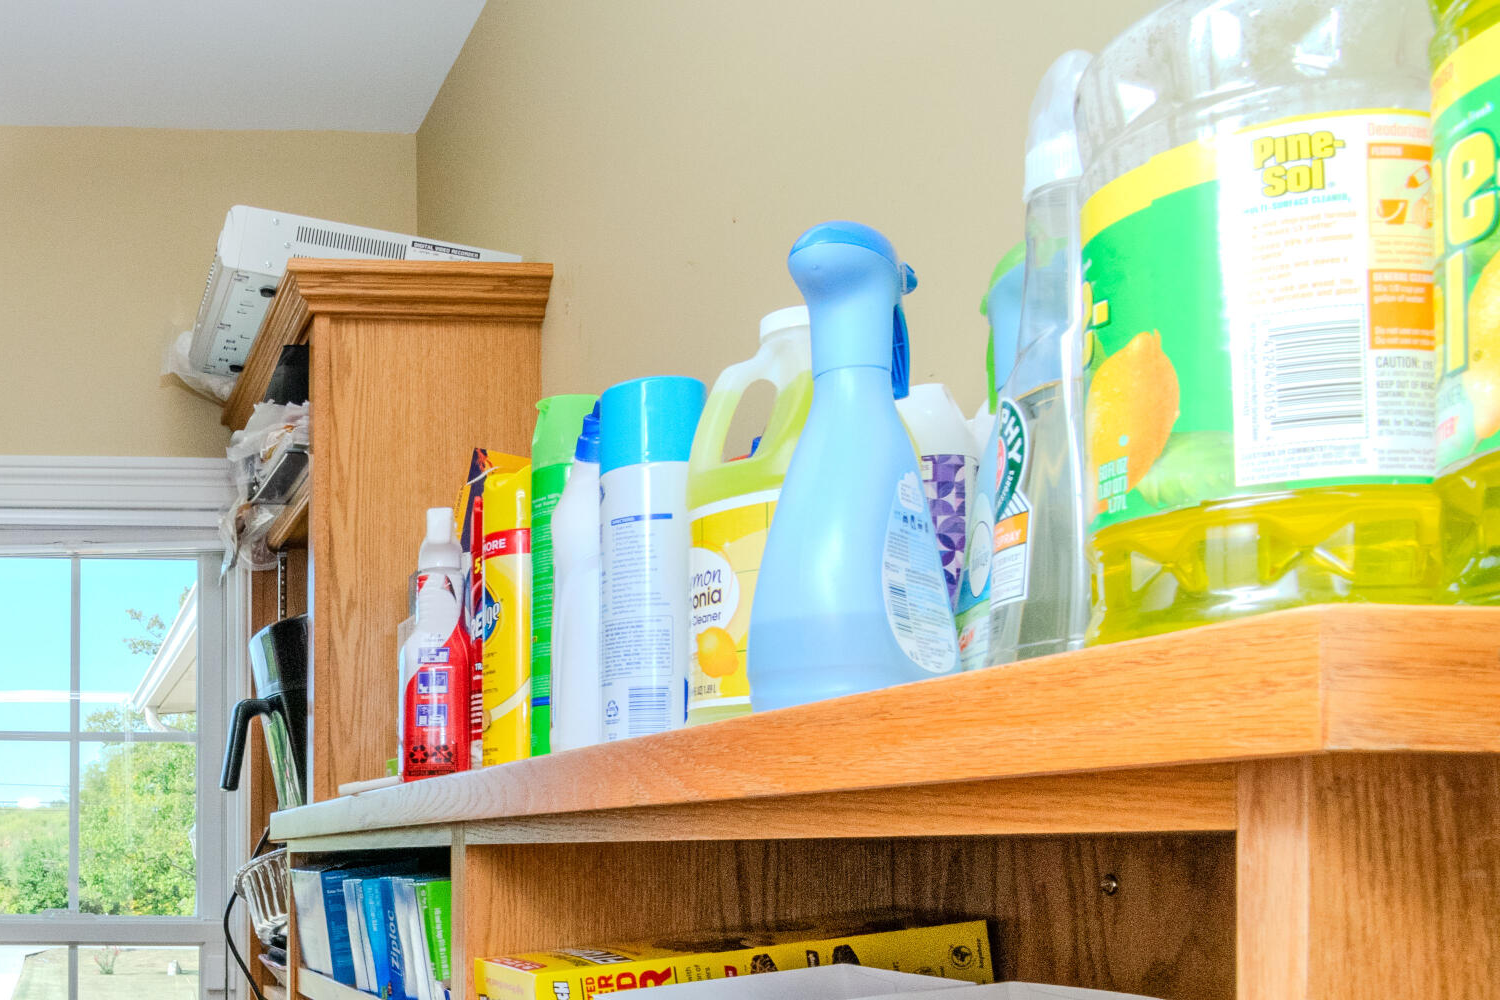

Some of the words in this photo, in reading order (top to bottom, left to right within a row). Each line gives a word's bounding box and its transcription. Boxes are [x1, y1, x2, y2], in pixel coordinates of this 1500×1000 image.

[1252, 131, 1346, 171] Pine-
[1262, 158, 1326, 198] Sol
[1001, 407, 1023, 465] PHY
